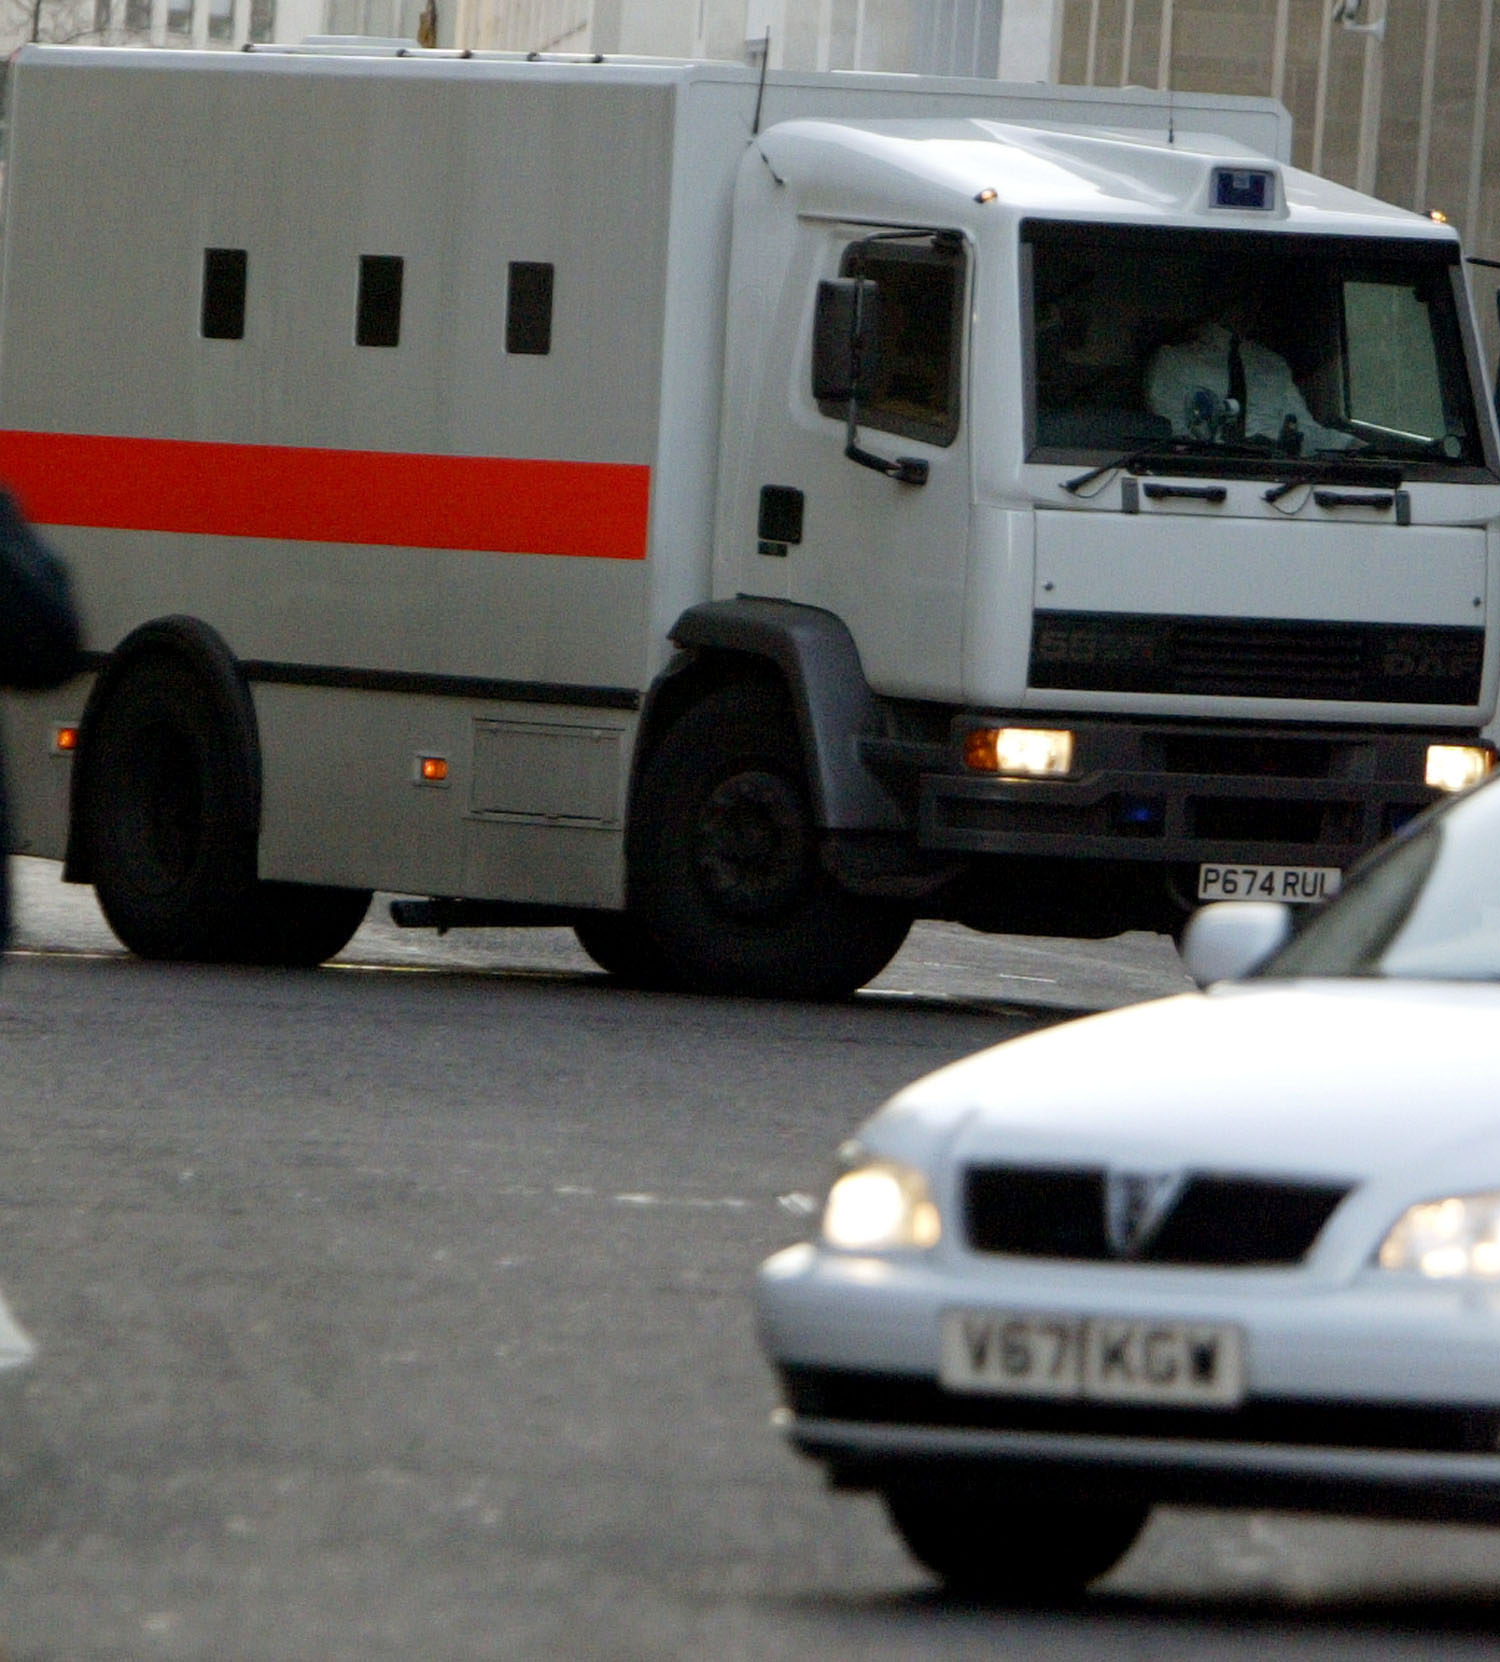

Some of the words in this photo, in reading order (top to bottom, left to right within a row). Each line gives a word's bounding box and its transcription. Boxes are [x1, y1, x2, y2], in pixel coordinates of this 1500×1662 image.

[1202, 867, 1276, 896] P674
[1282, 871, 1328, 898] RUL
[1100, 1326, 1220, 1388] KGW
